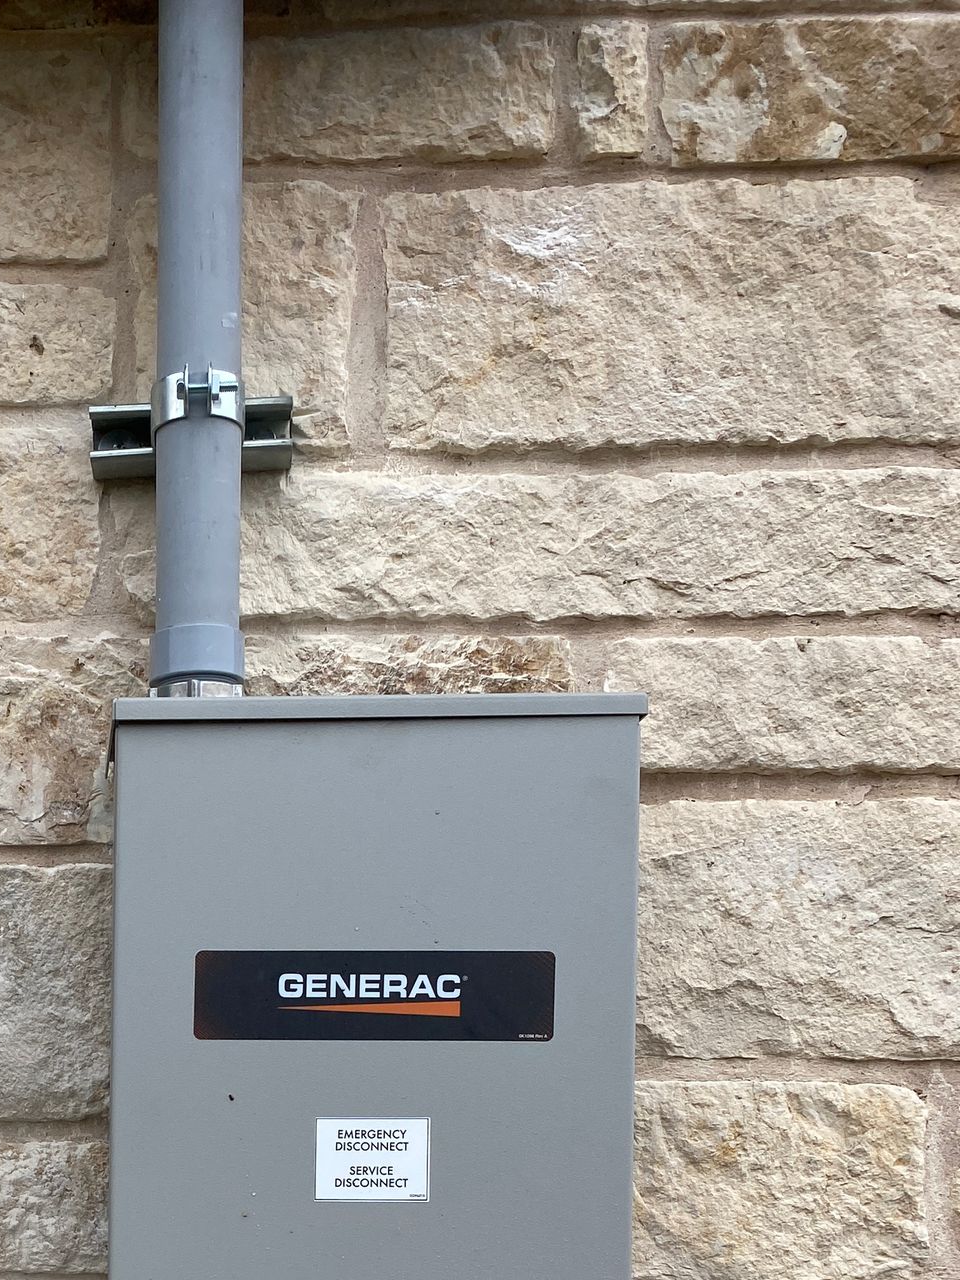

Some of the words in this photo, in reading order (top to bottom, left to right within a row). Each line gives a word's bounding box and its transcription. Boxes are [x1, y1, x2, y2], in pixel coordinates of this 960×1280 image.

[337, 1129, 407, 1139] EMERGENCY
[335, 1141, 409, 1151] DISCONNECT
[349, 1166, 393, 1175] SERVICE
[334, 1178, 409, 1188] DISCONNECT
